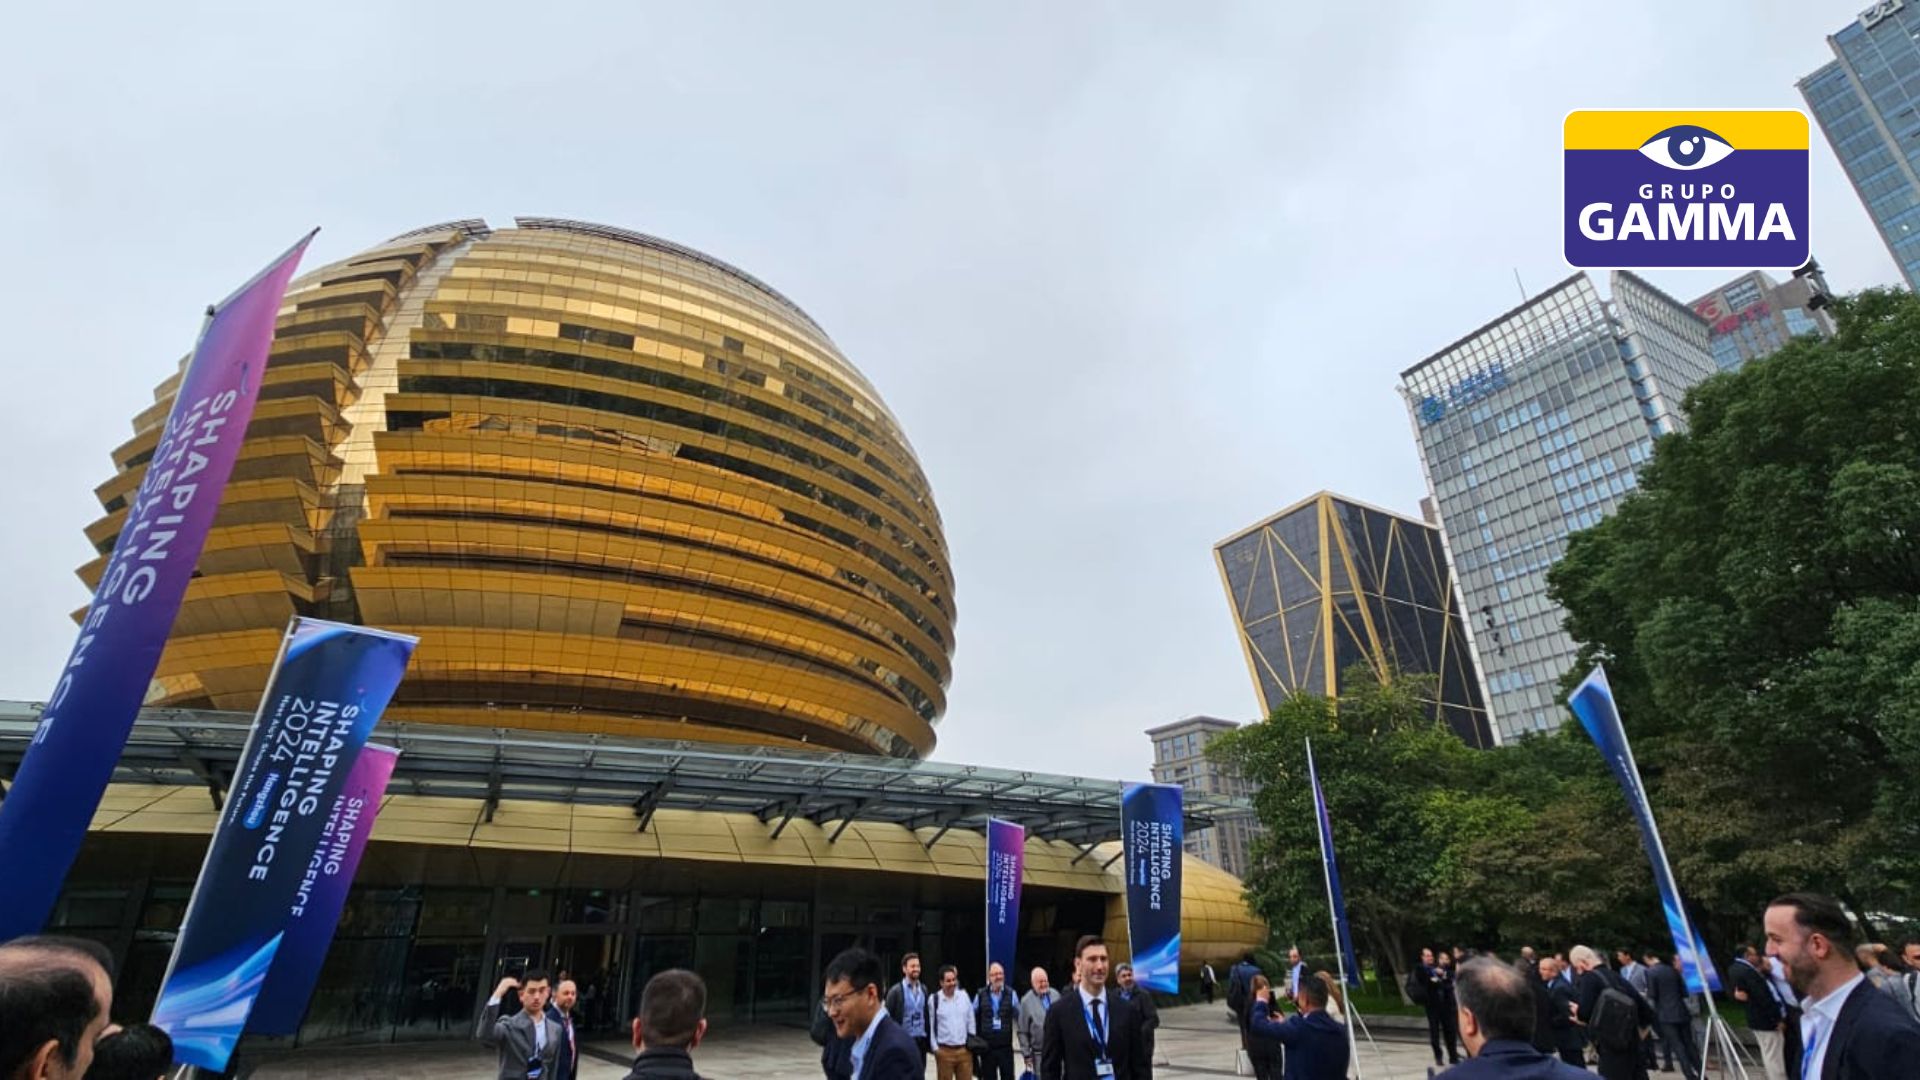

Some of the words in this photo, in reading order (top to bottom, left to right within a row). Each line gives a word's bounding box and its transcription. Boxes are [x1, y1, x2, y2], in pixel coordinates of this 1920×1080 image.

[122, 389, 236, 605] SHAPING
[31, 397, 210, 745] INTELLIGENCE
[270, 697, 315, 762] 2024
[298, 704, 360, 817] SHAPING
[247, 772, 279, 824] Hangzhou
[248, 700, 340, 881] INTELLIGENCE
[323, 797, 363, 876] SHAPING
[1136, 821, 1149, 854] 2024
[1150, 822, 1161, 911] INTELLIGENCE
[1160, 823, 1172, 880] SHAPING
[998, 852, 1010, 925] INTELLIGENCE
[1007, 853, 1017, 900] SHAPING
